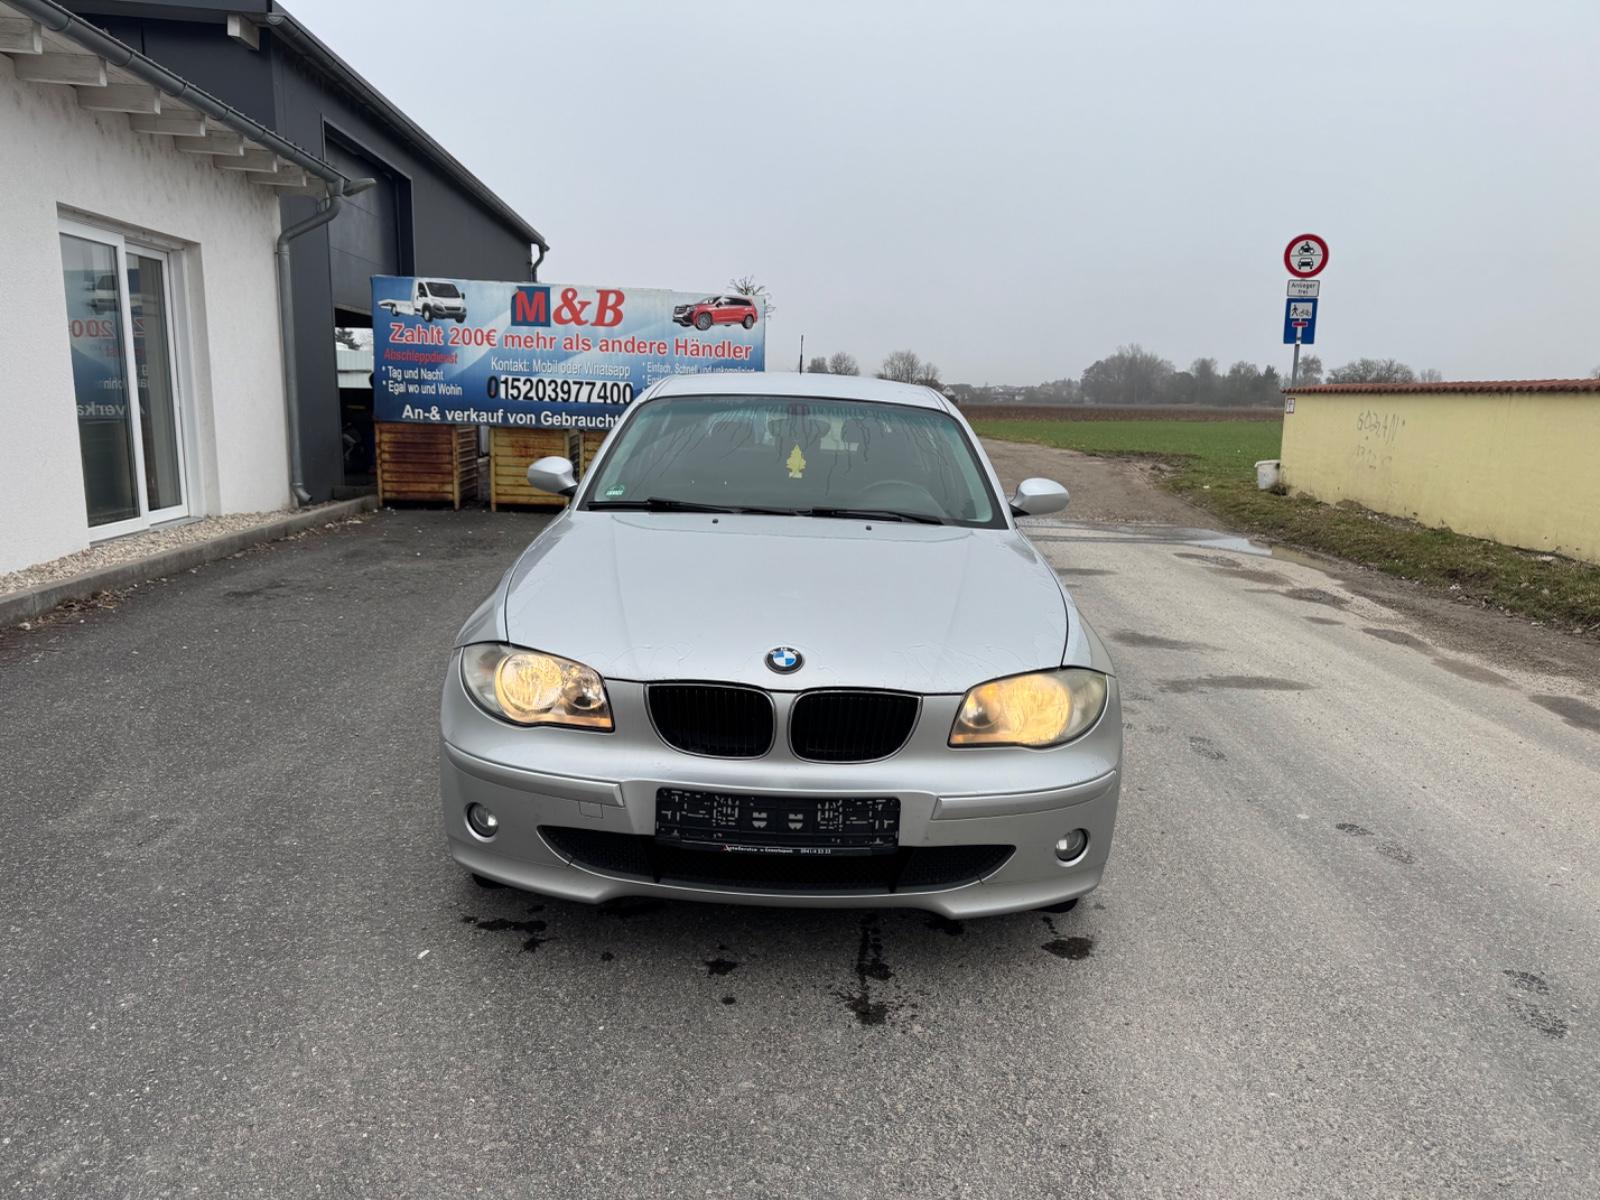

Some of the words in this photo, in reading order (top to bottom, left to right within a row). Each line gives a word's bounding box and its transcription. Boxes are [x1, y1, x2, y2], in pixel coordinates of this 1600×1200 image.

[515, 287, 625, 328] M&B
[389, 322, 443, 345] Zahlt
[448, 327, 498, 347] 200€
[504, 332, 556, 350] mehr
[563, 333, 592, 352] als
[599, 335, 668, 356] andere
[674, 338, 753, 360] Händler
[387, 365, 403, 381] Tag
[404, 368, 419, 379] und
[421, 369, 444, 381] Nacht
[491, 356, 530, 372] Kontakt:
[561, 362, 582, 375] oder
[585, 362, 631, 378] Whatsapp
[388, 380, 407, 395] Egal
[408, 384, 420, 394] wo
[421, 383, 436, 395] und
[438, 383, 463, 396] Wohin
[487, 375, 633, 405] 015203977400
[446, 408, 503, 423] verkauf
[508, 413, 536, 424] von
